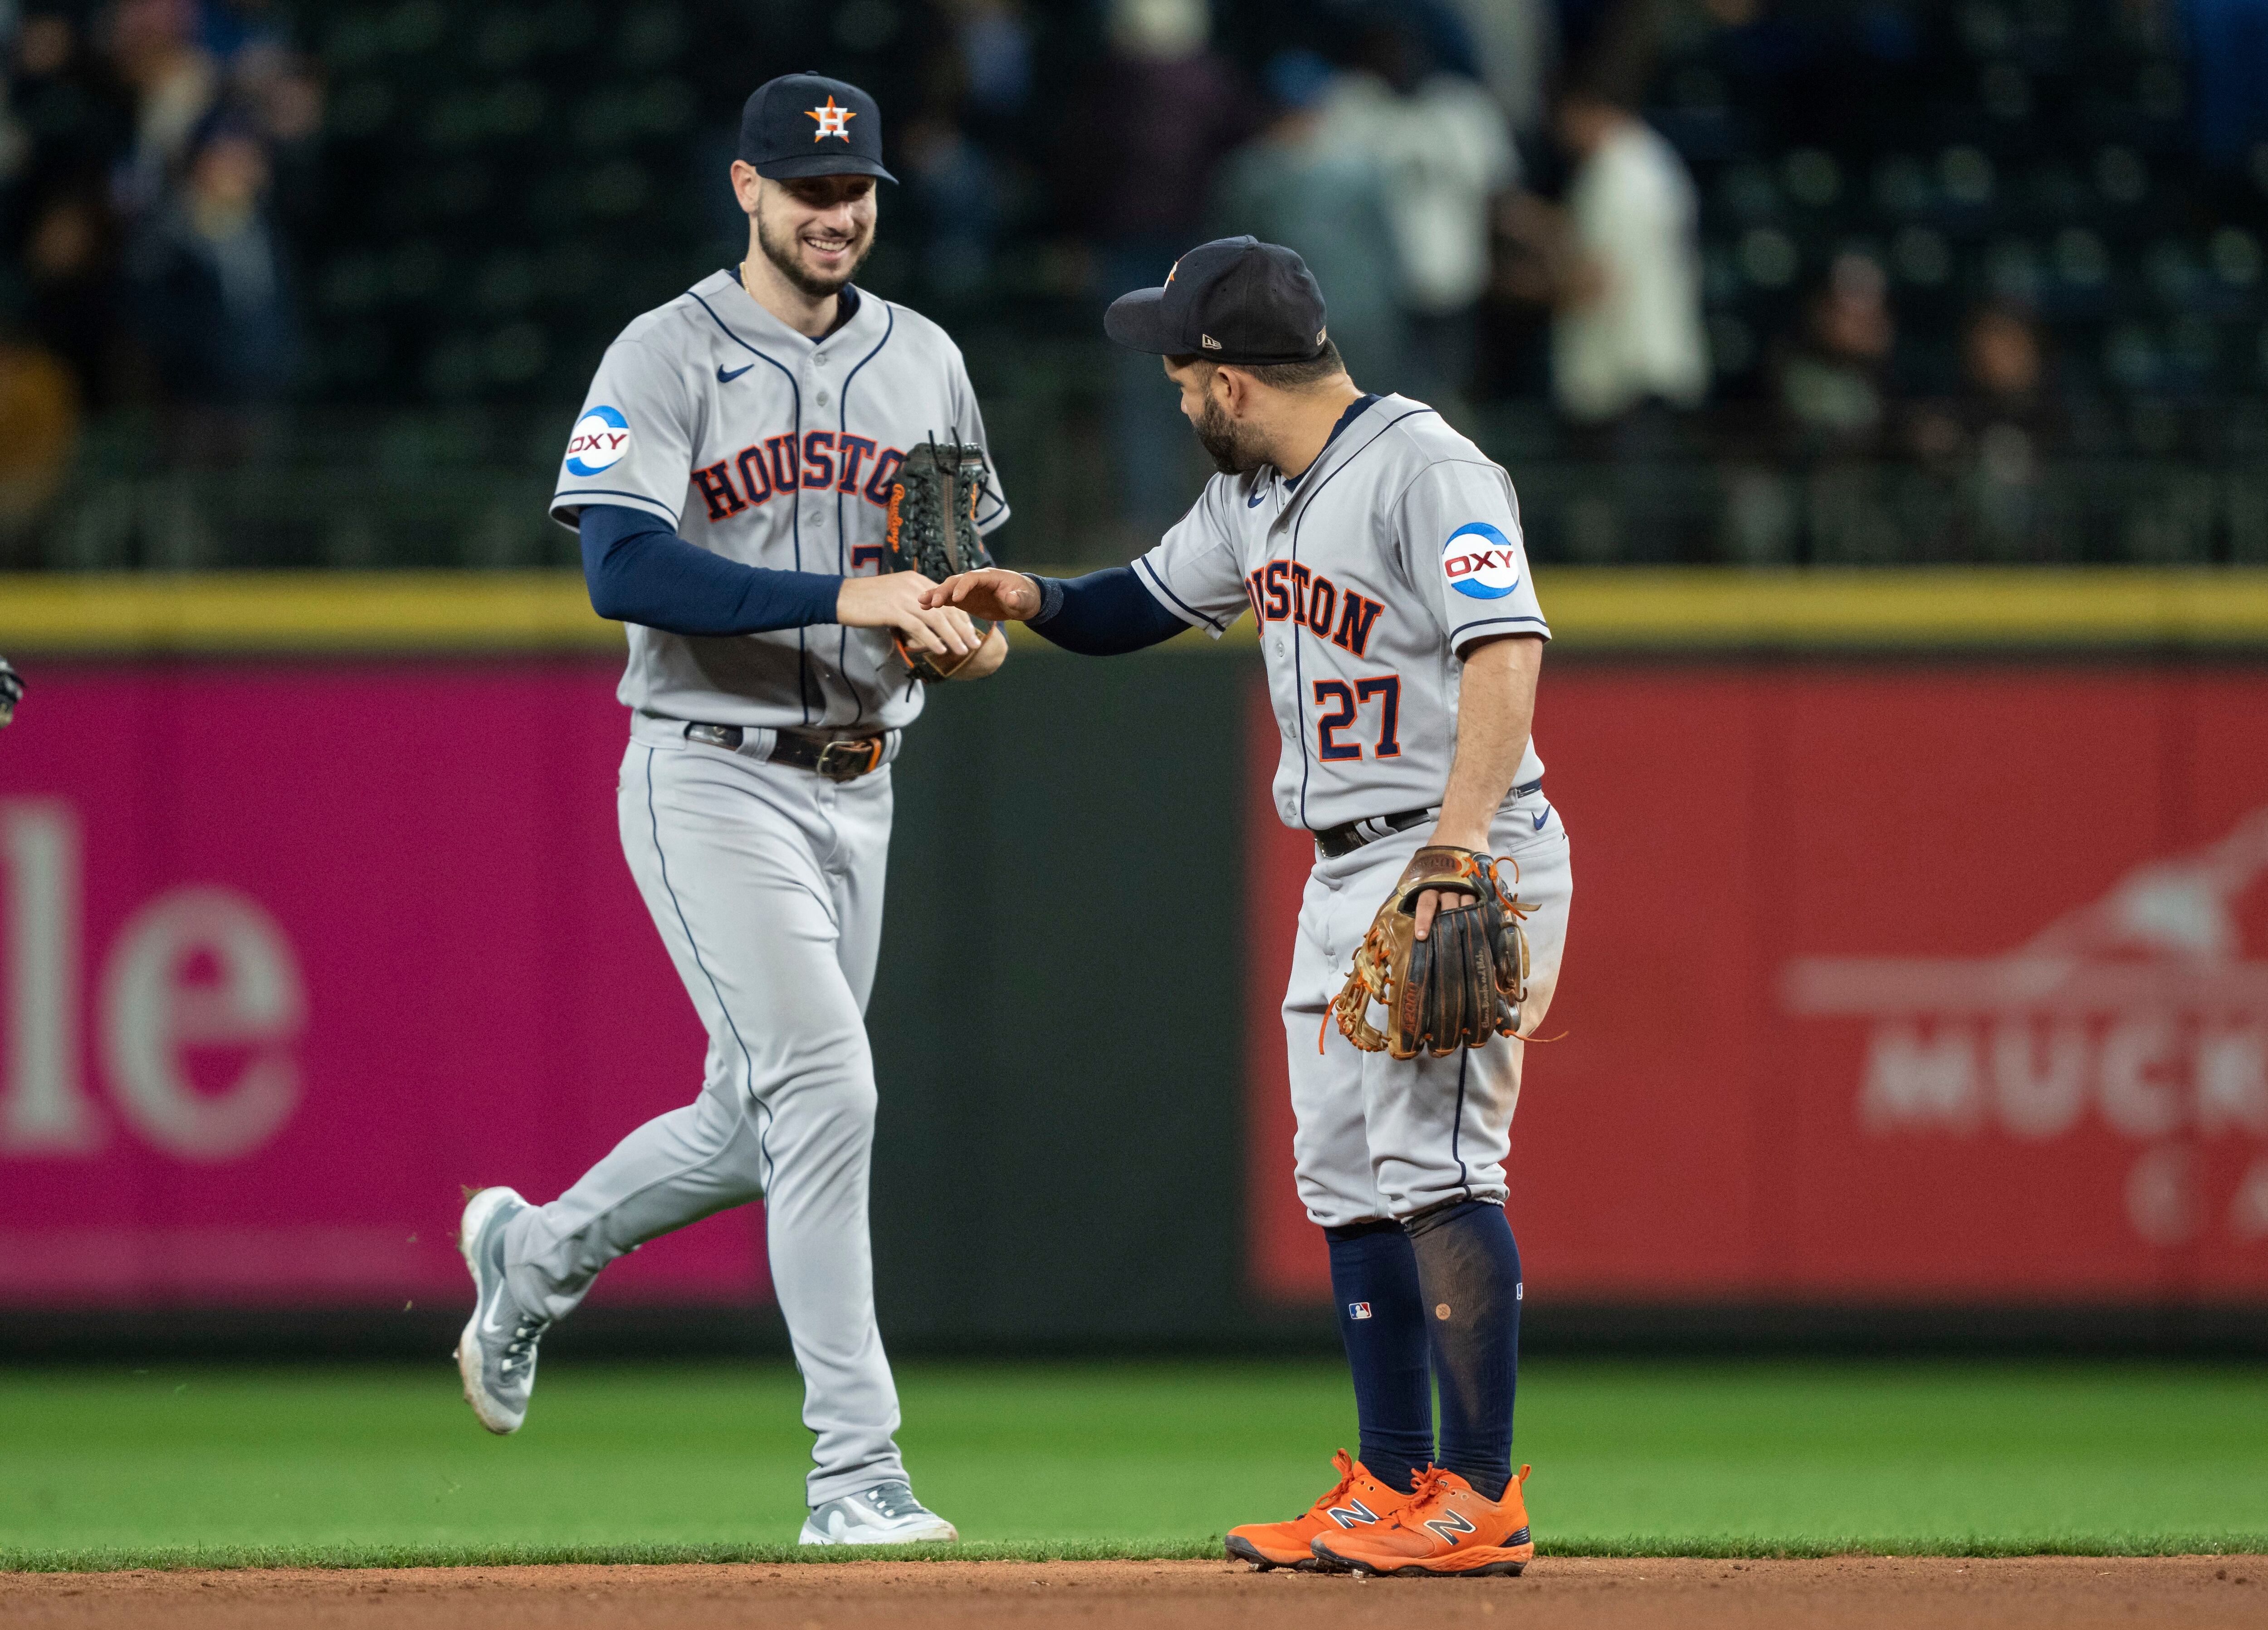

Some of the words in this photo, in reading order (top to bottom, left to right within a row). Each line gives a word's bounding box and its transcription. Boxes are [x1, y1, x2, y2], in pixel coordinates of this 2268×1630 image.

[568, 433, 627, 454] OXY
[1445, 550, 1517, 578] OXY
[1313, 674, 1401, 762] 27
